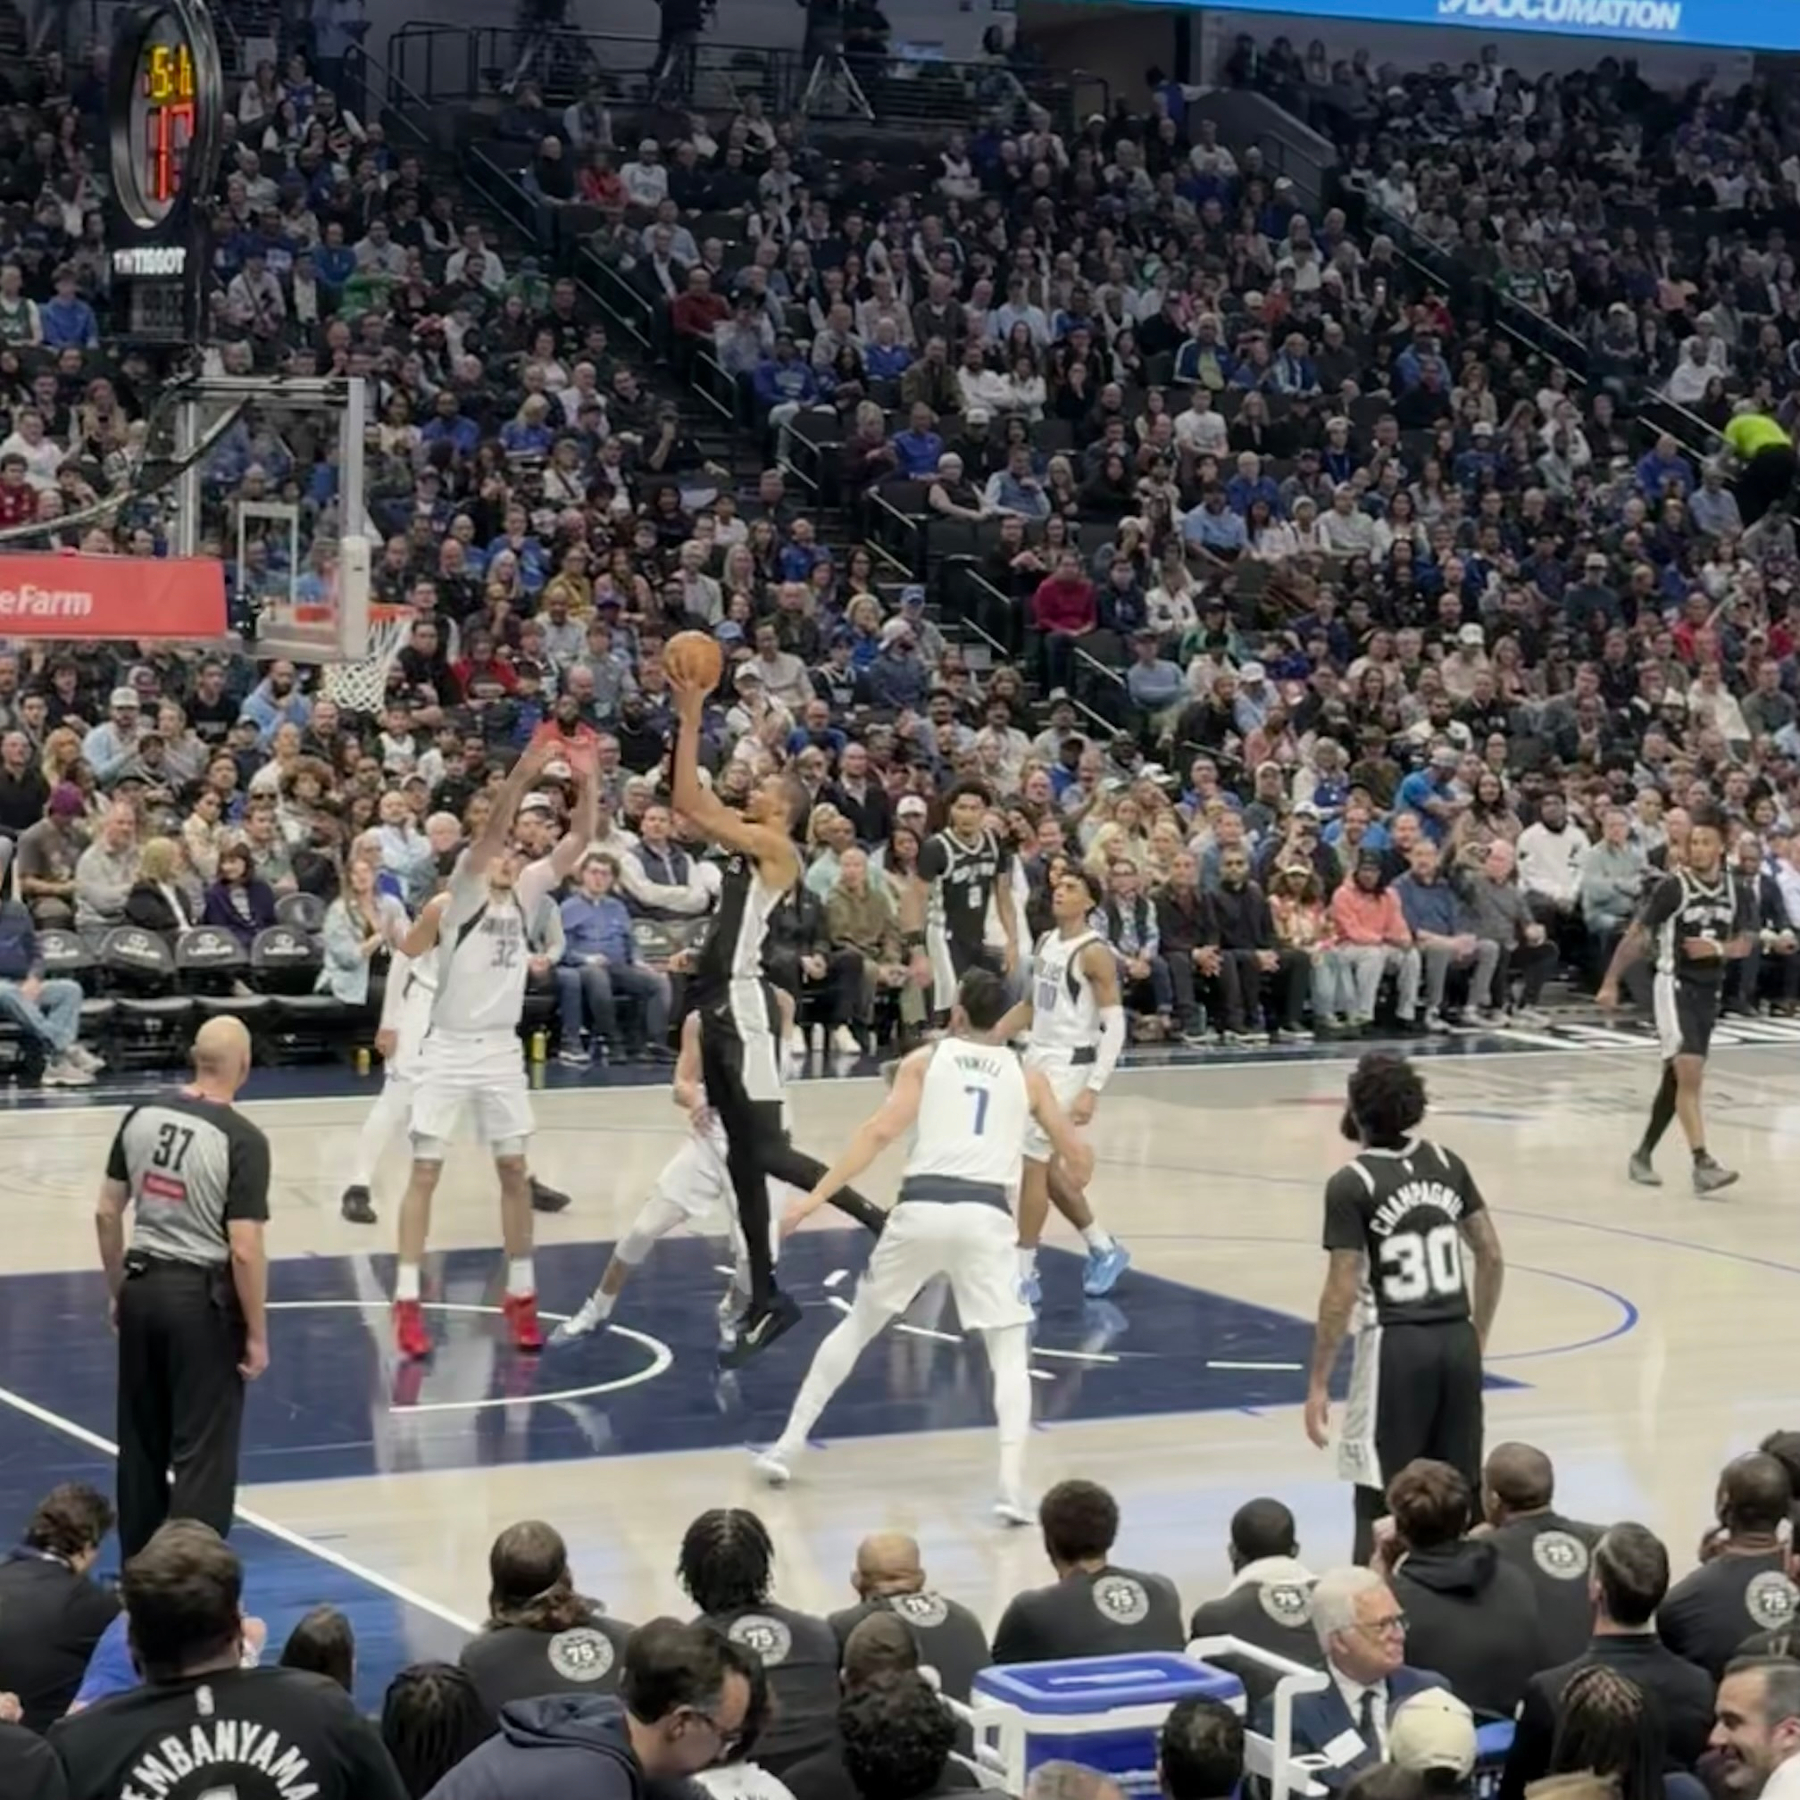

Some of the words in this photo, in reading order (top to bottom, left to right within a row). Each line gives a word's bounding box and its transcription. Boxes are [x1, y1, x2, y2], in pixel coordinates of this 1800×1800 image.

[1465, 0, 1682, 30] DOCUMATION
[964, 1086, 990, 1136] 7
[153, 1123, 195, 1171] 37
[1380, 1224, 1462, 1303] 30
[1107, 1587, 1134, 1607] 75
[566, 1642, 595, 1664] 75
